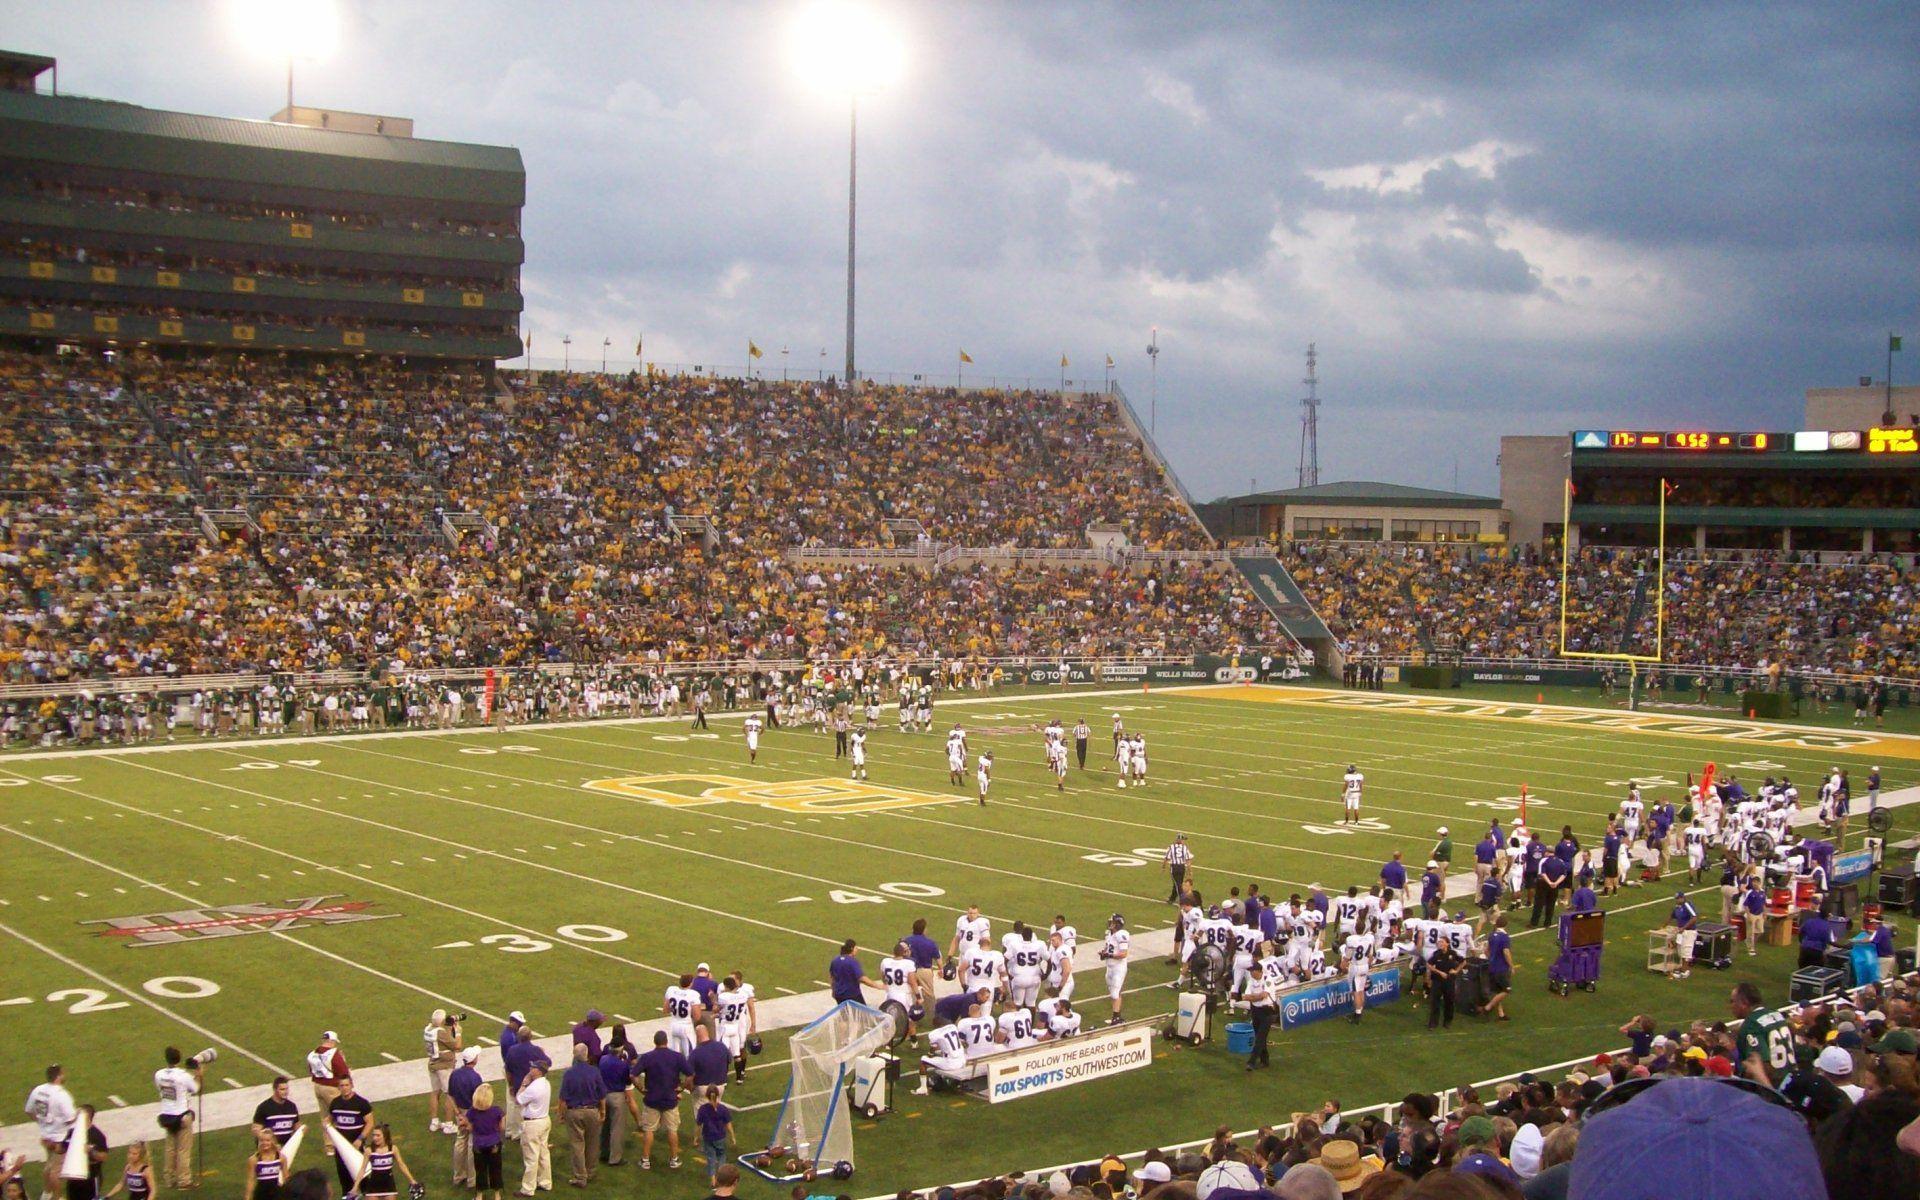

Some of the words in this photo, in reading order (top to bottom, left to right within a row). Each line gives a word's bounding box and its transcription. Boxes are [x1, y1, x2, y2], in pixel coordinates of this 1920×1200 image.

[829, 881, 946, 904] 40
[1341, 903, 1357, 920] 12
[479, 924, 629, 953] 30
[1207, 927, 1226, 944] 86
[1237, 935, 1255, 953] 24
[971, 958, 994, 978] 54
[1016, 951, 1038, 967] 65
[46, 976, 220, 1014] 20
[1300, 998, 1326, 1014] Time
[1326, 989, 1355, 1007] Warn
[669, 997, 689, 1019] 36
[971, 1023, 993, 1044] 73
[1013, 1018, 1032, 1039] 60
[1025, 1055, 1060, 1071] FOLLOW
[1062, 1052, 1077, 1063] THE
[1079, 1045, 1106, 1059] BEARS
[1107, 1041, 1119, 1052] ON
[273, 1120, 293, 1129] JACKS
